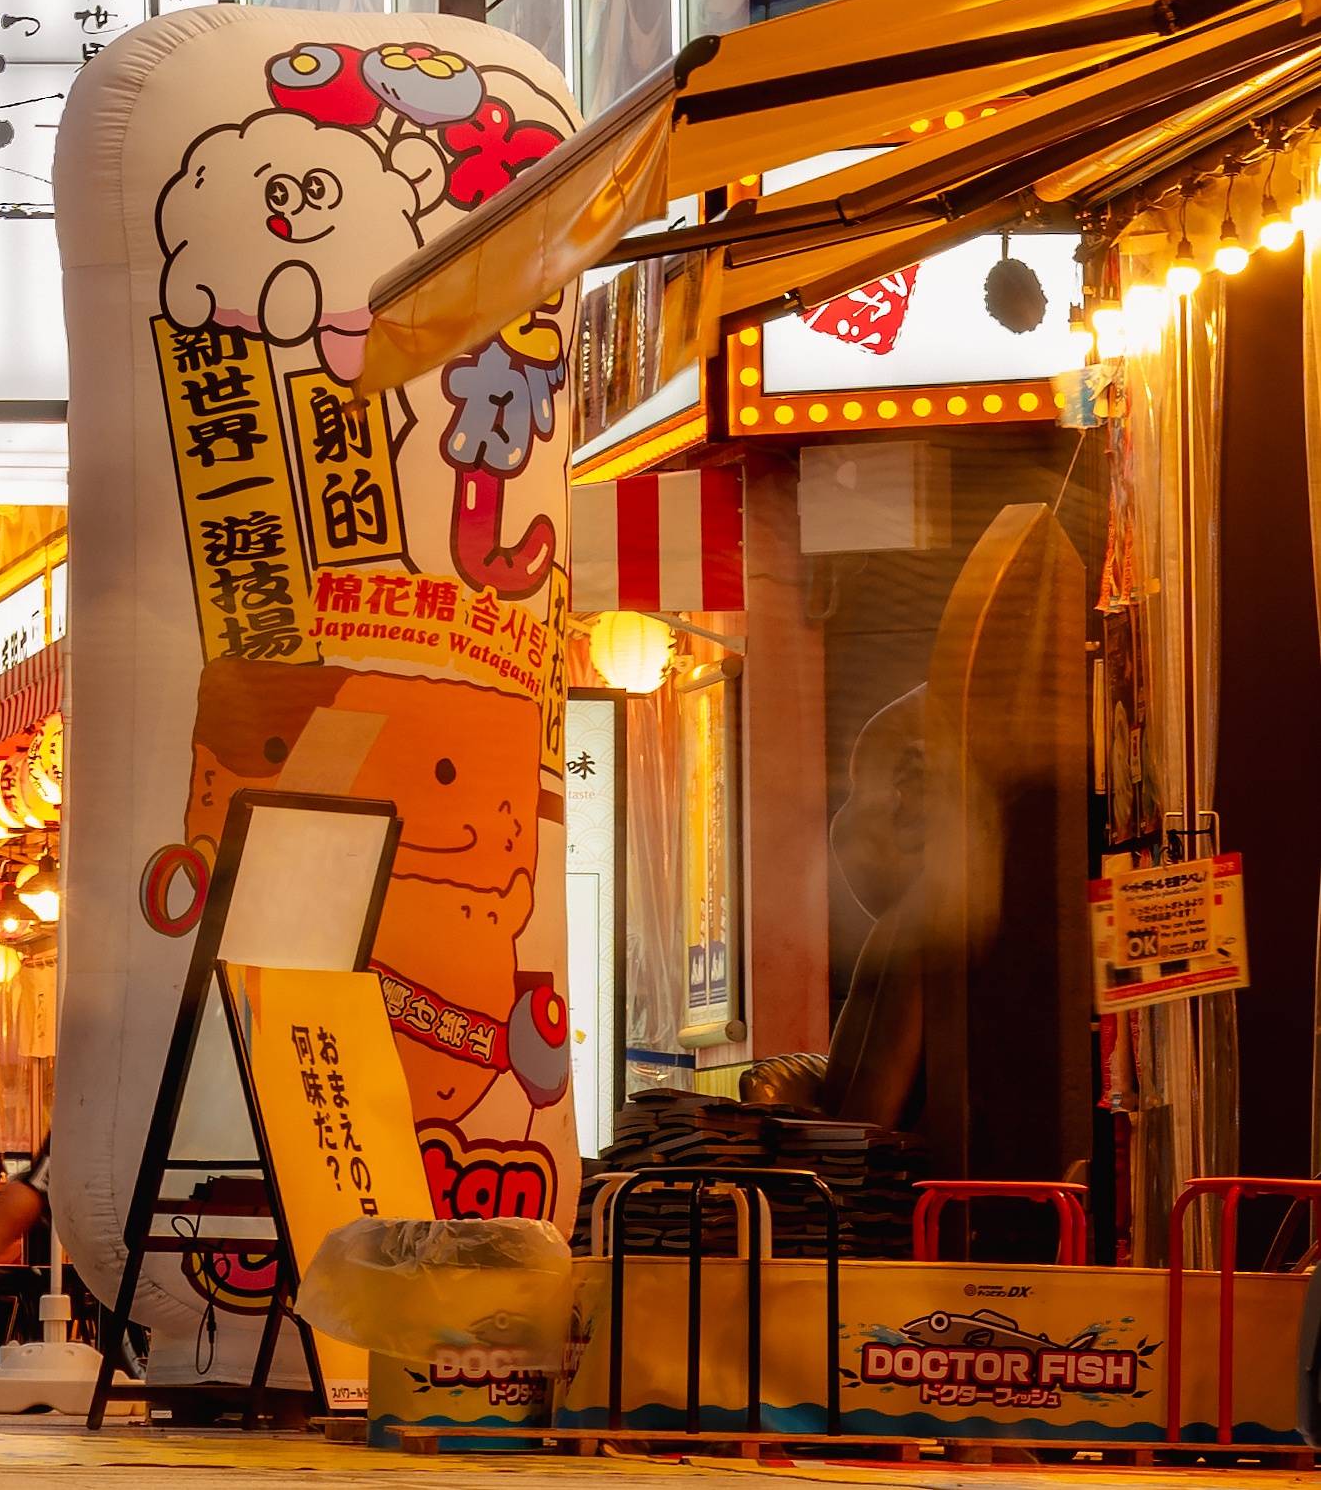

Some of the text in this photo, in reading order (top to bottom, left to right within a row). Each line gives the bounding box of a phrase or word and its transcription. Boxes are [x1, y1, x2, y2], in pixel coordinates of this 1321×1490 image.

[310, 387, 388, 546] 射的
[314, 572, 458, 622] 棉花糖
[471, 591, 547, 668] 솜사탕
[309, 617, 541, 696] Japanease Watagashi
[1128, 935, 1157, 957] OK
[867, 1348, 1131, 1385] DOCTOR FISH
[922, 1385, 1058, 1406] ドクターフィッシュ
